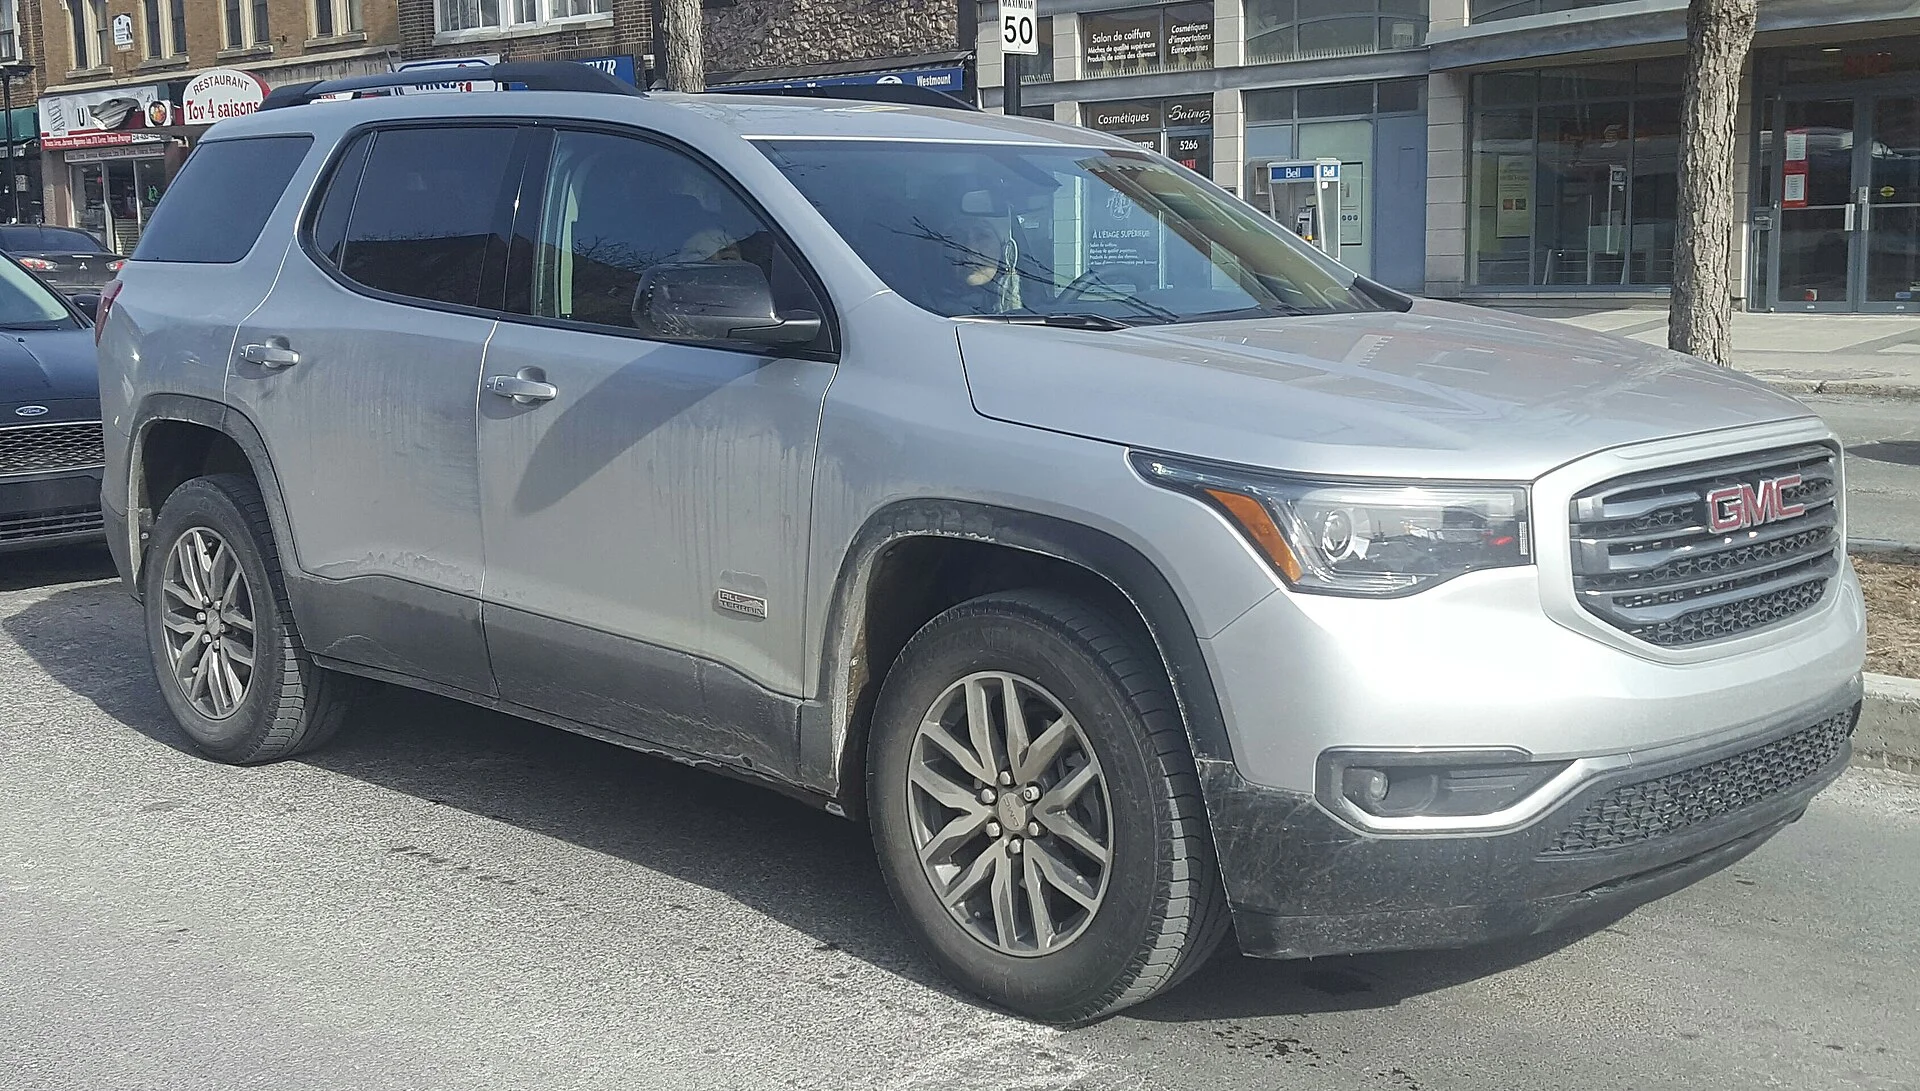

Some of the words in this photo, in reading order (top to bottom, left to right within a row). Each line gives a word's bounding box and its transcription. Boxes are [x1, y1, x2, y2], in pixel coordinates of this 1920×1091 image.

[1002, 0, 1033, 9] MAXIMUM
[1004, 16, 1032, 44] 50
[1171, 22, 1209, 34] Cosmétiques
[1092, 32, 1112, 43] Salon
[1113, 31, 1123, 41] de
[1124, 28, 1151, 40] coiffure
[1168, 33, 1211, 45] d'importations
[1106, 44, 1113, 52] de
[1113, 43, 1129, 53] qualité
[1130, 42, 1156, 51] supérieure
[1171, 44, 1209, 56] Européennes
[1087, 53, 1106, 63] Produits
[1107, 53, 1113, 61] de
[1127, 51, 1136, 59] des
[1137, 50, 1156, 58] cheveux
[193, 75, 250, 95] RESTAURANT
[917, 74, 951, 87] Westmount
[208, 98, 215, 119] 4
[218, 98, 259, 118] saisons
[1097, 112, 1150, 125] Cosmétiques
[1179, 140, 1199, 150] 5266
[1285, 167, 1301, 178] Bell
[1323, 166, 1335, 177] Bell
[1707, 474, 1805, 533] GMC
[721, 593, 740, 602] ALL
